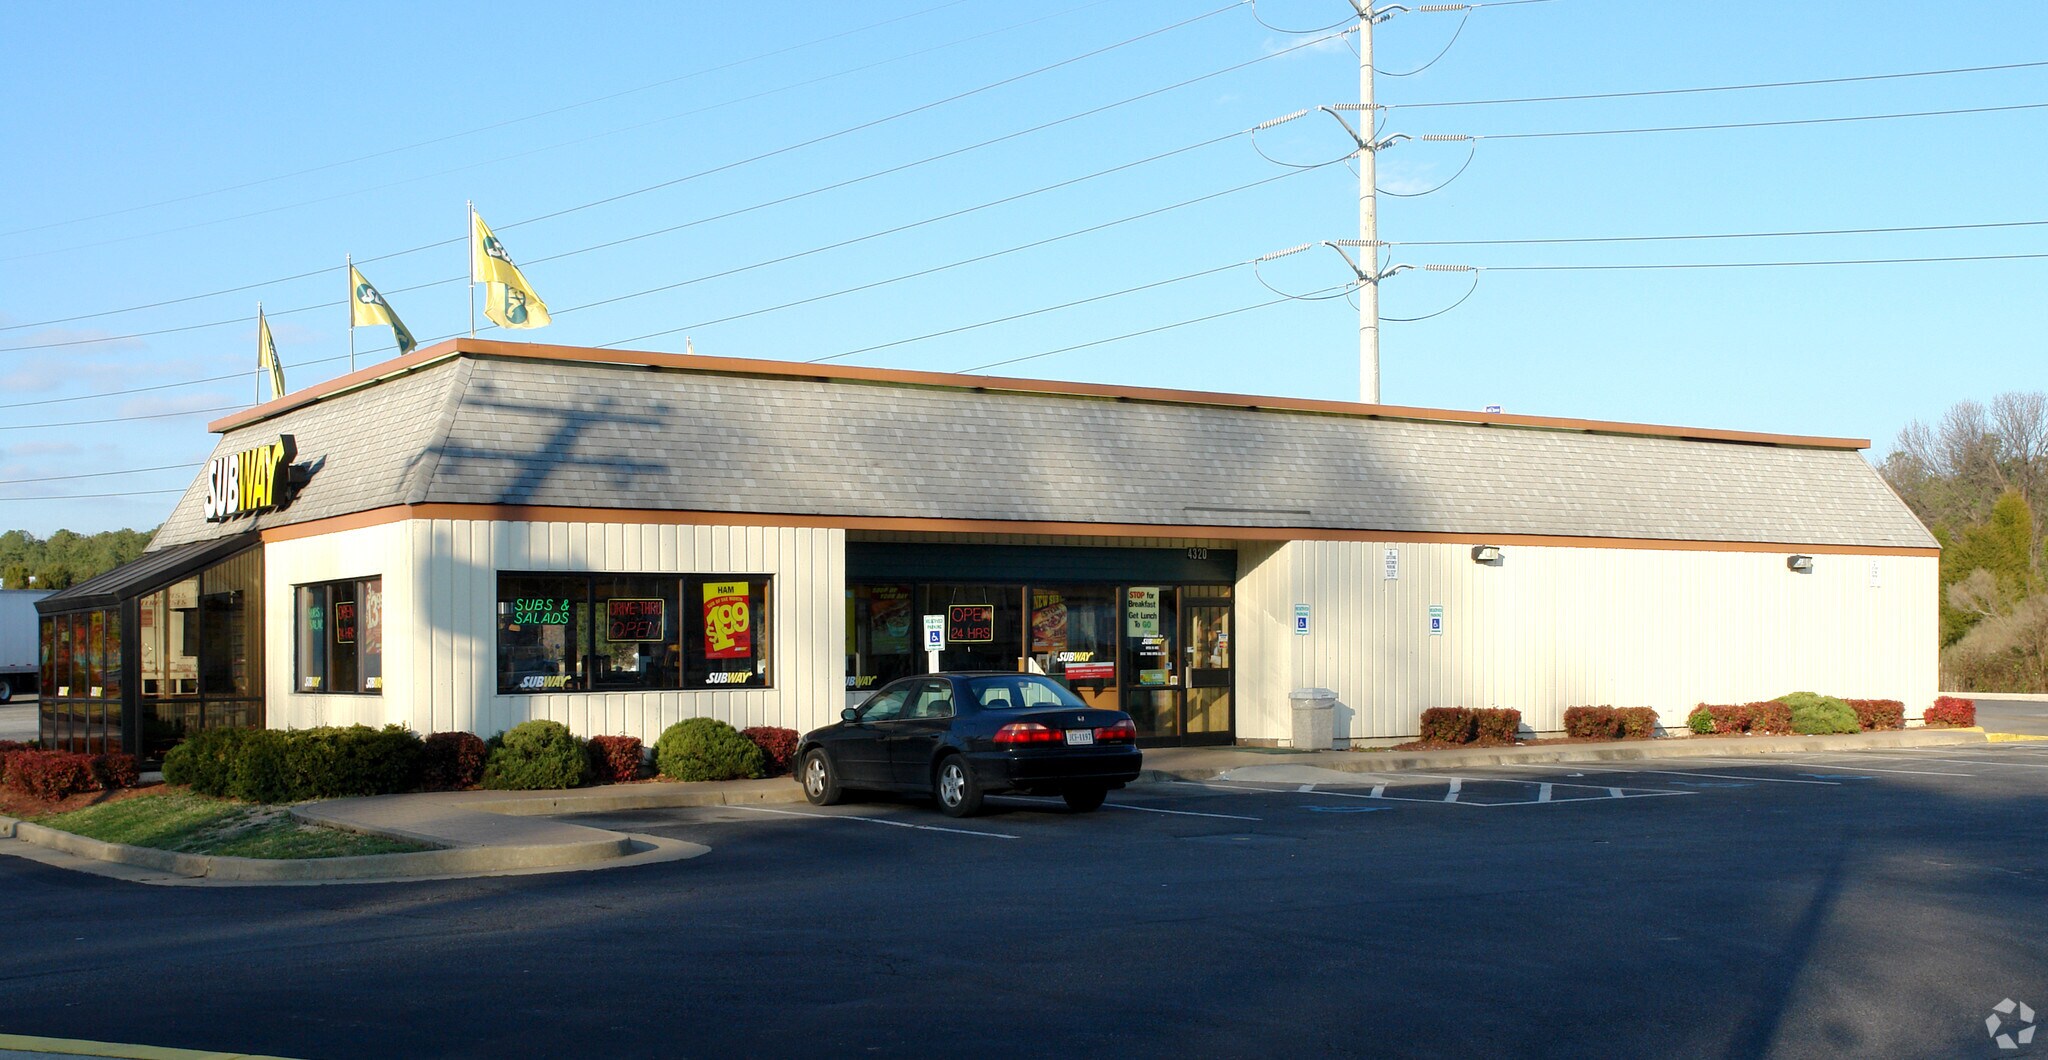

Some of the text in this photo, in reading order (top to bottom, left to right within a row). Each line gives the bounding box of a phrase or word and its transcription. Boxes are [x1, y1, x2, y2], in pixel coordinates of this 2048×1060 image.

[204, 435, 285, 519] SUBWAY
[1187, 548, 1208, 560] 4320
[717, 586, 735, 594] HAM
[1129, 591, 1145, 599] STOP
[514, 599, 570, 611] SUBS &
[1128, 600, 1156, 608] Breakfast
[514, 612, 570, 624] SALADS
[951, 607, 992, 622] OPEN
[610, 621, 661, 638] OPEN
[1134, 620, 1151, 628] To GO
[951, 627, 990, 639] 24 HRS
[1057, 652, 1094, 662] SUBWAY
[520, 675, 572, 688] SUBWAY
[706, 671, 753, 684] SUBWAY
[845, 675, 877, 688] UBWAY
